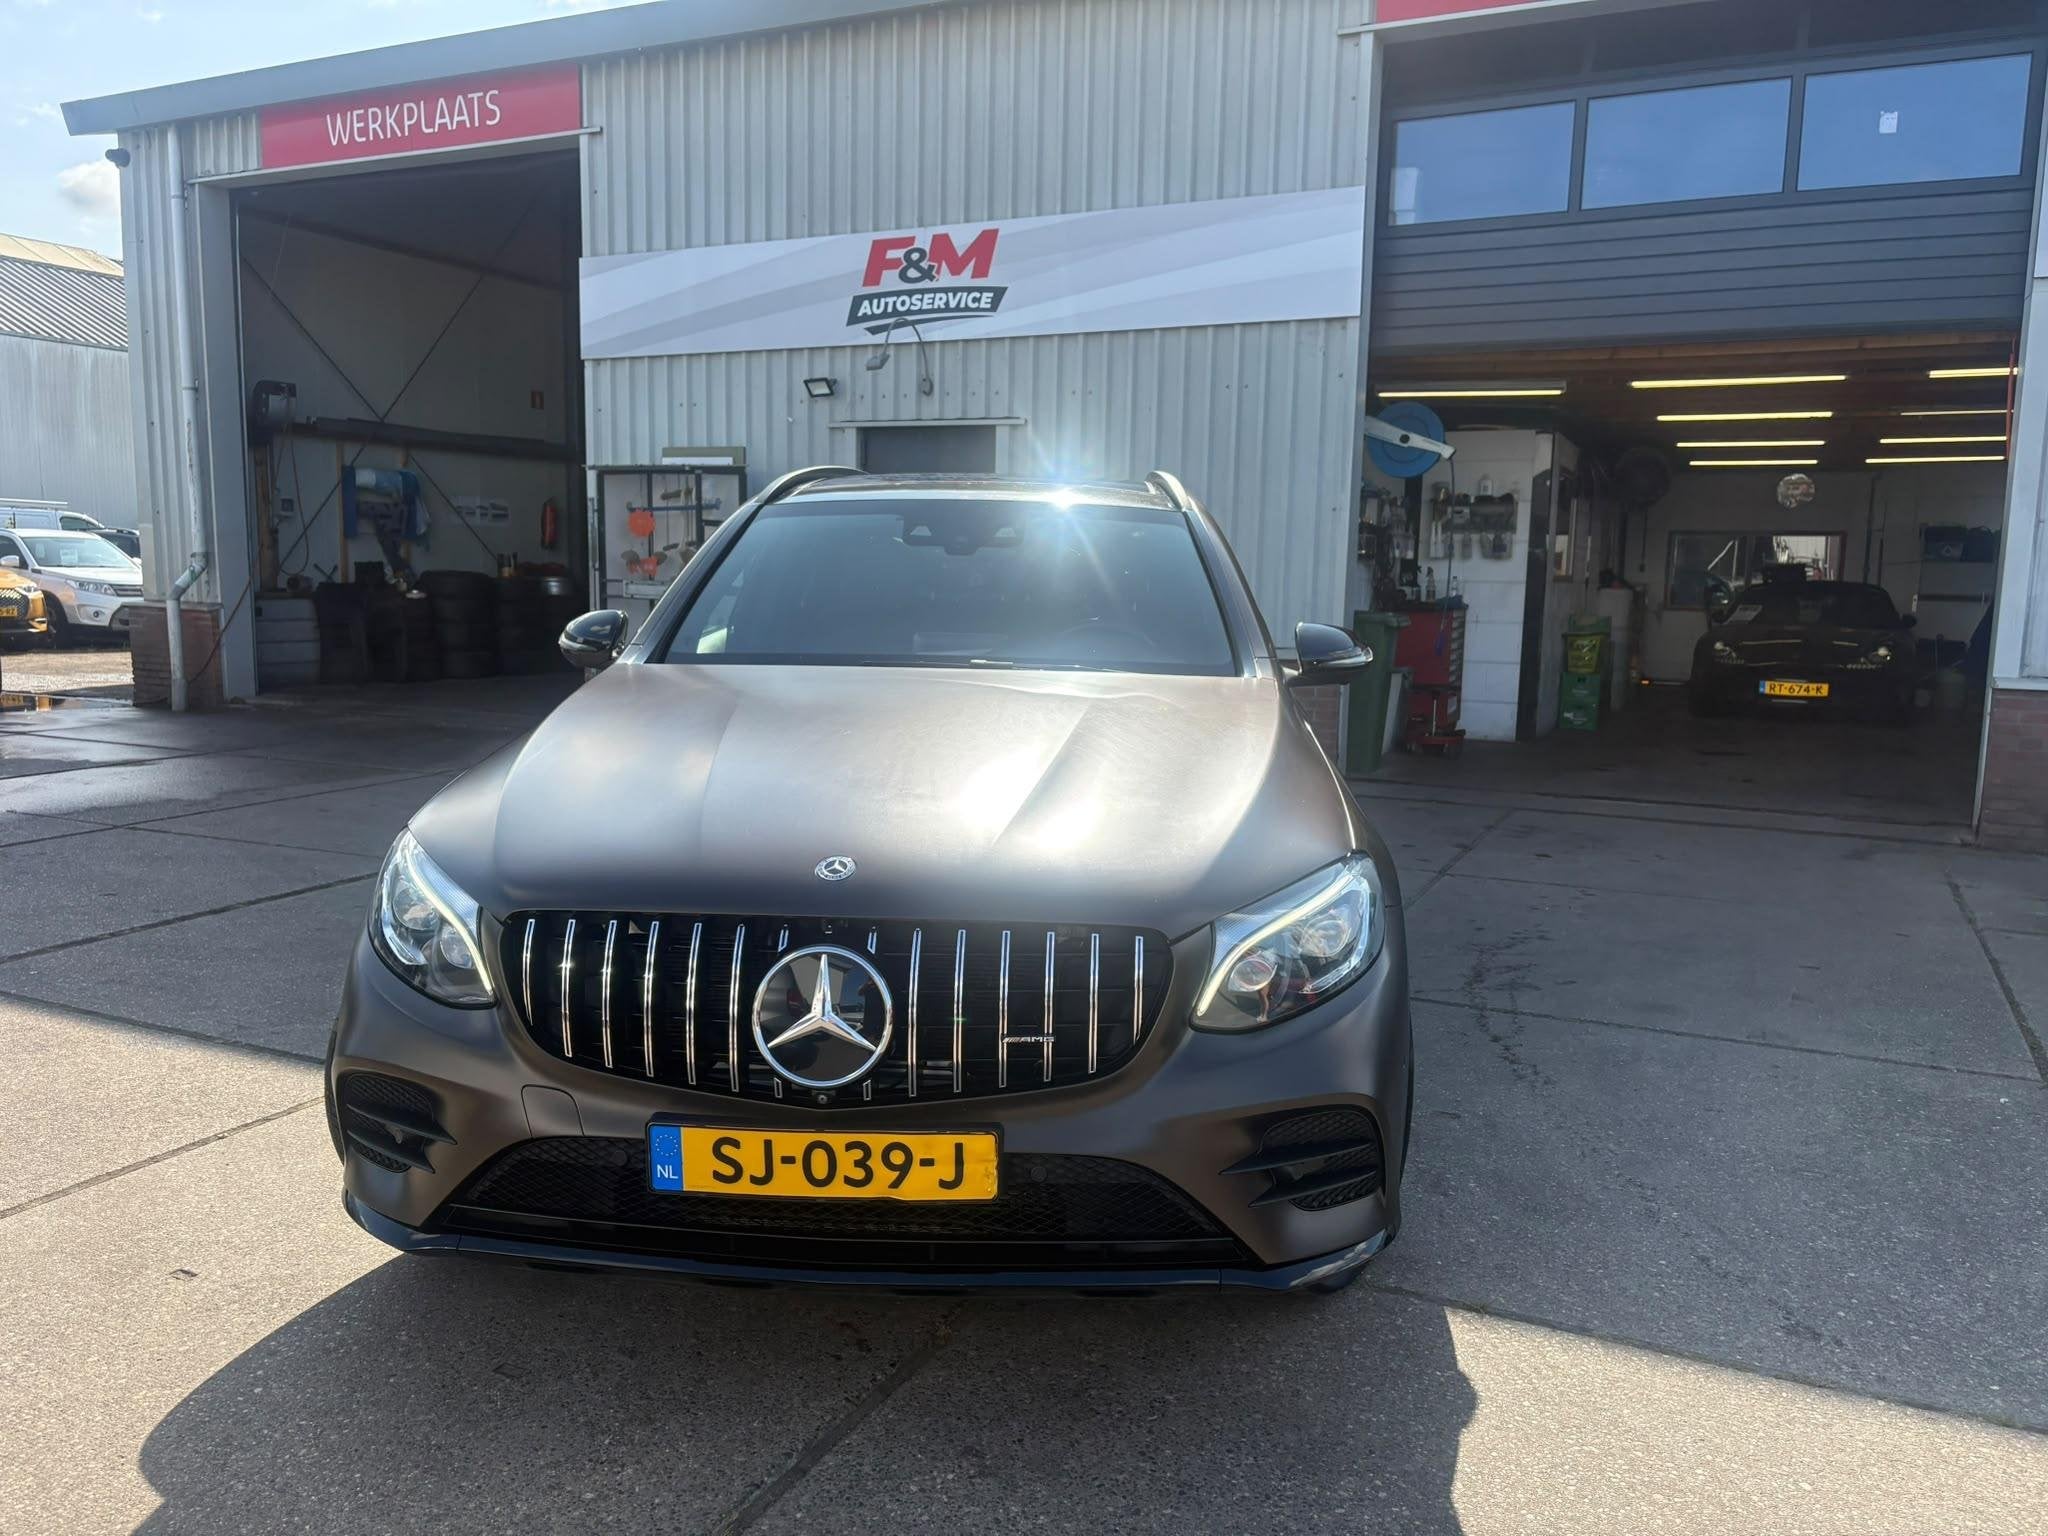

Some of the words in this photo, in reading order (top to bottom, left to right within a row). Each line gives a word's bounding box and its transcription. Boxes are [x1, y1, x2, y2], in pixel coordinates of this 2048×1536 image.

[326, 90, 500, 146] WERKPLAATS
[862, 228, 999, 287] F&M
[857, 292, 993, 316] AUTOSERVICE
[1769, 683, 1823, 695] RT-674-K
[656, 1164, 679, 1179] NL
[711, 1136, 964, 1190] SJ-039-J
